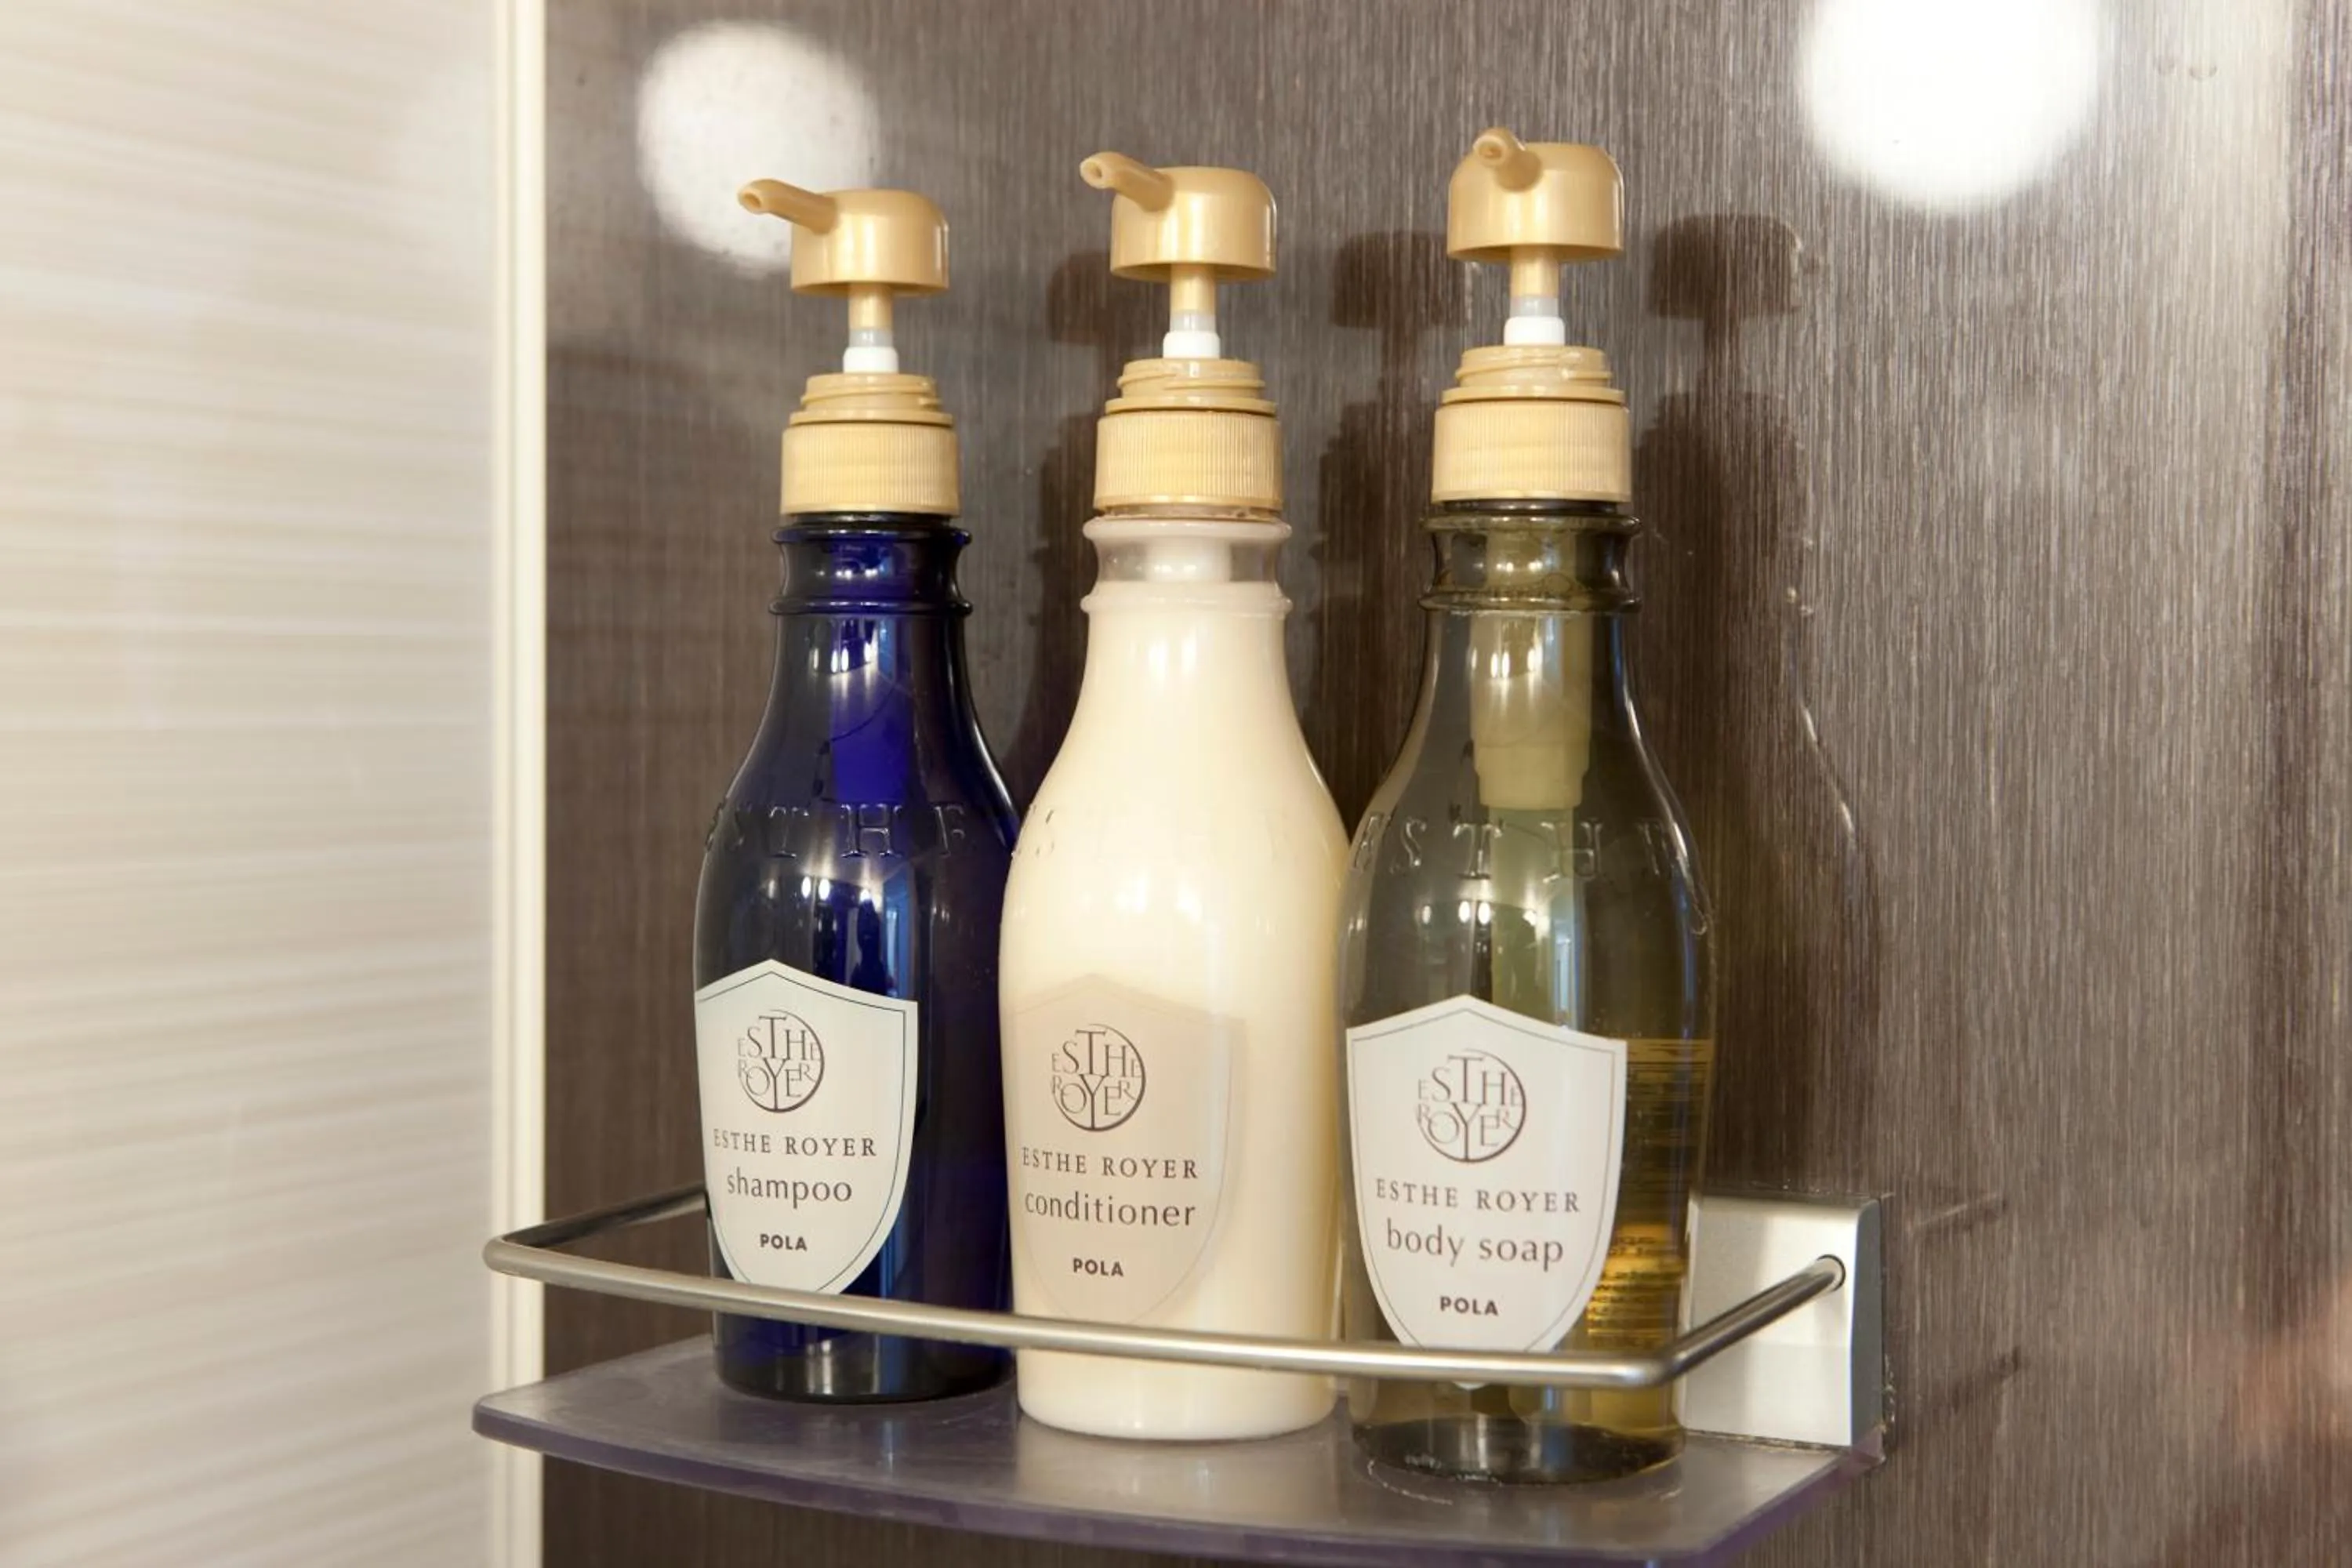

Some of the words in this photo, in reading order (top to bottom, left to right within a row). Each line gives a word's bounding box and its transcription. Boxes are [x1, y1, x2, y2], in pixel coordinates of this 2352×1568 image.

[713, 1128, 771, 1153] ESTHE
[785, 1135, 877, 1157] ROYER
[1022, 1146, 1087, 1174] ESTHE
[1102, 1156, 1199, 1180] ROYER
[727, 1166, 853, 1210] shampoo
[1376, 1178, 1459, 1208] ESTHE
[1475, 1189, 1581, 1213] ROYER
[1025, 1190, 1196, 1227] conditioner
[759, 1232, 808, 1252] POLA
[1386, 1217, 1465, 1268] body
[1479, 1238, 1564, 1272] soap
[1072, 1257, 1124, 1278] POLA
[1439, 1294, 1499, 1317] POLA
